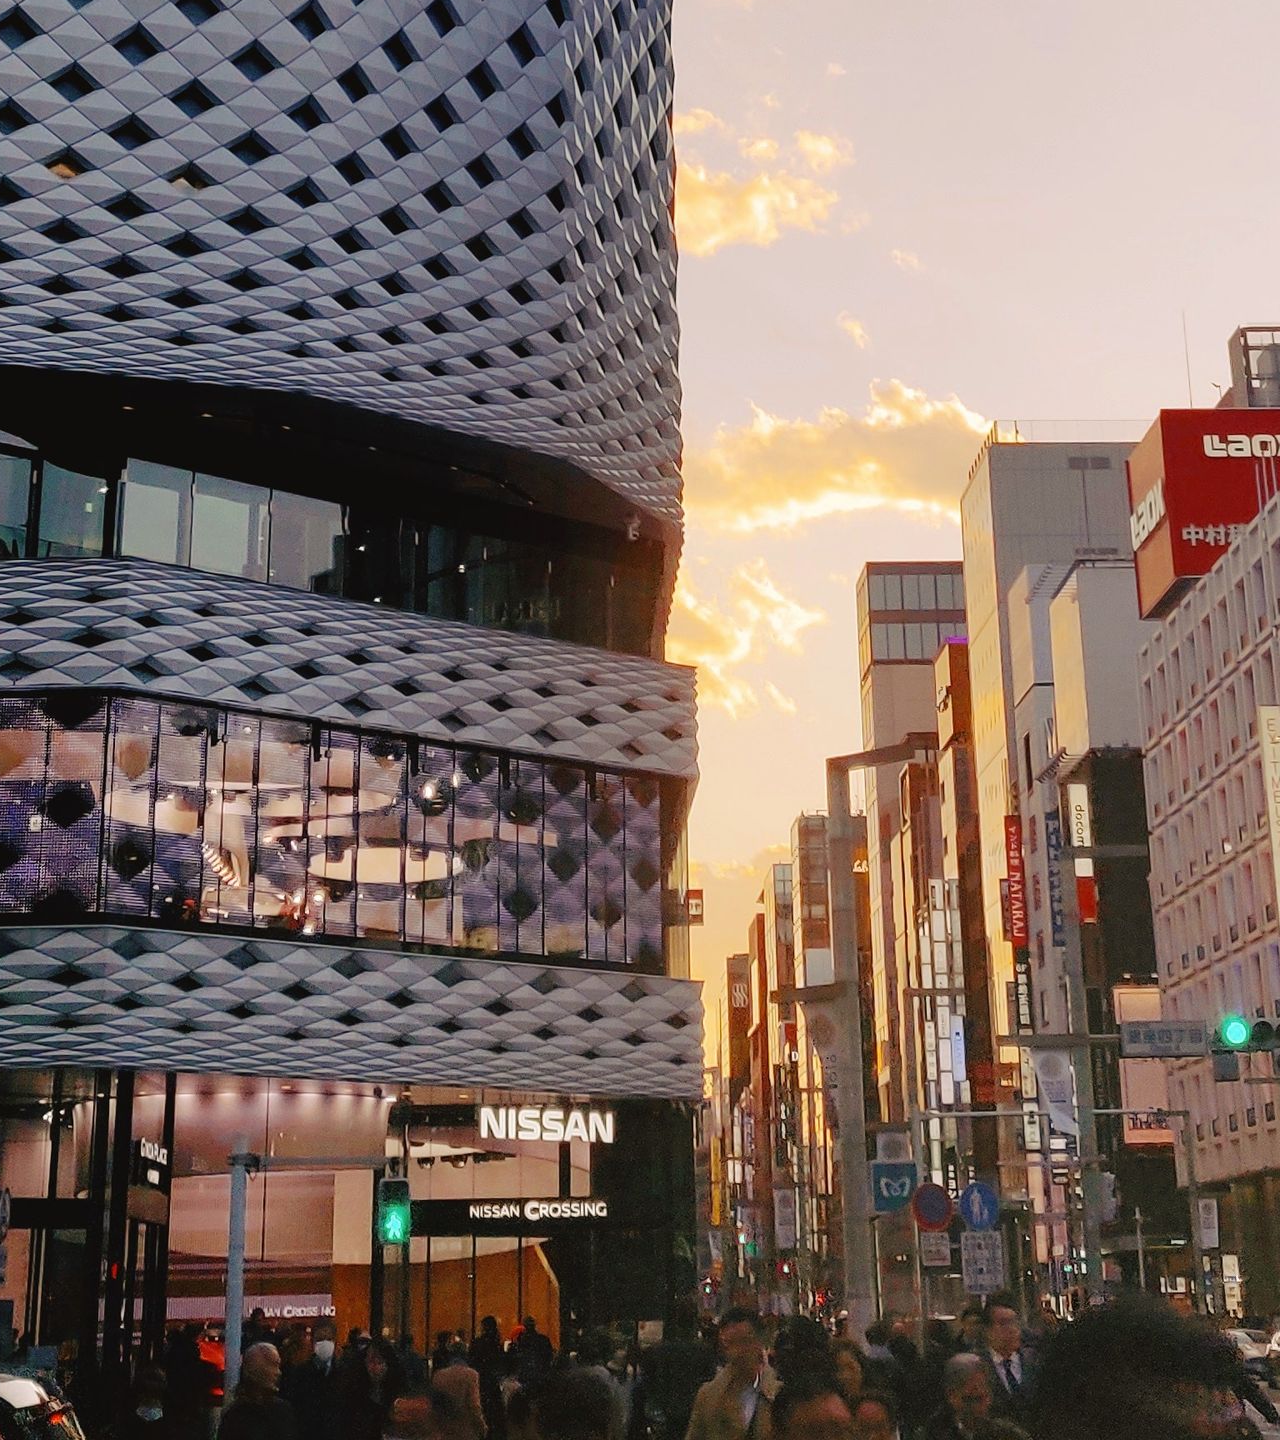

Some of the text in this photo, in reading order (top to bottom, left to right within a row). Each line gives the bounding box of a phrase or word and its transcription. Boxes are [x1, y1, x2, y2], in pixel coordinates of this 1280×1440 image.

[1009, 872, 1025, 937] NATARAJ
[481, 1107, 614, 1143] NISSAN
[470, 1200, 608, 1221] NISSAN CROSSING
